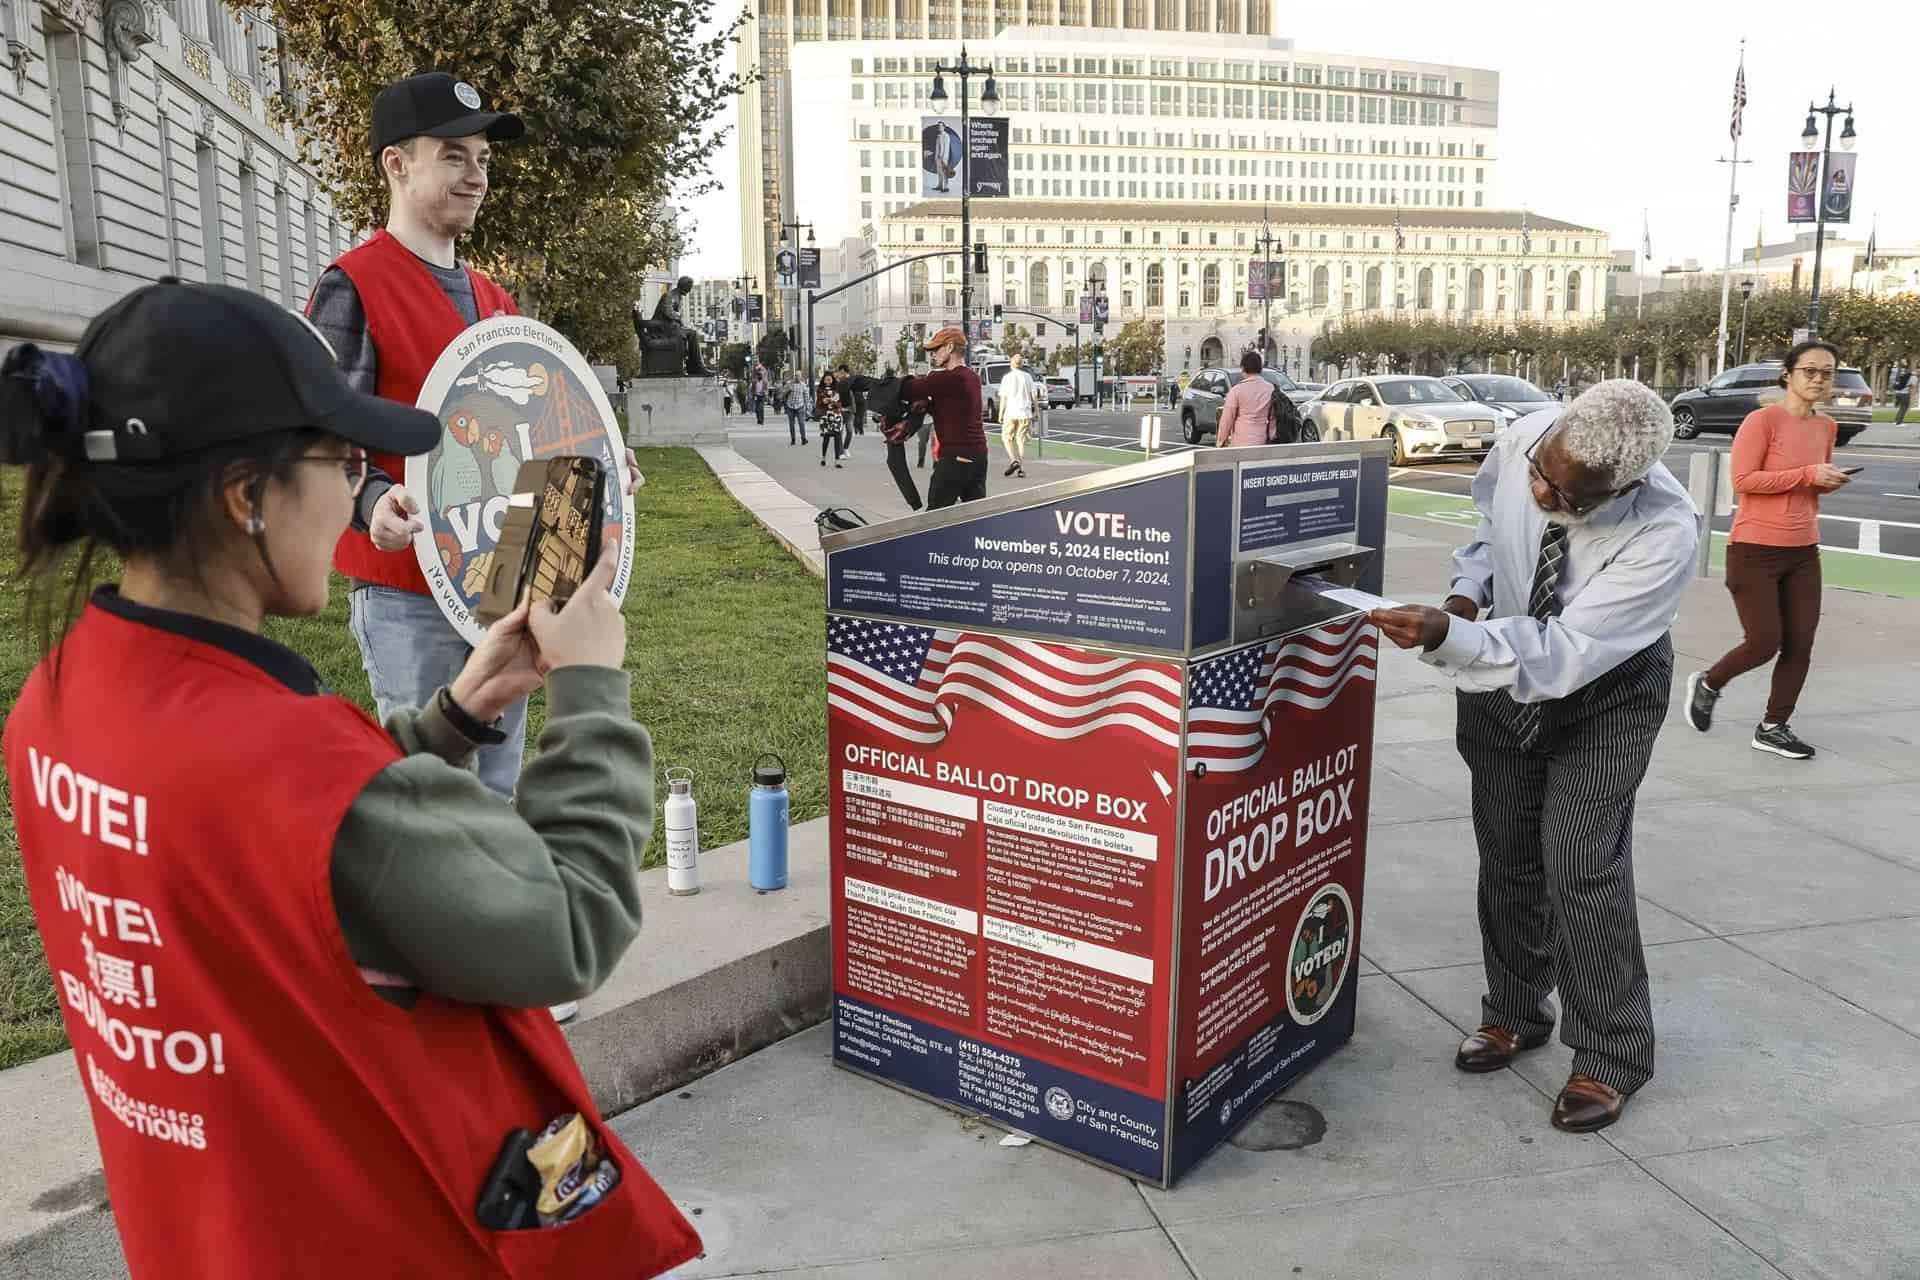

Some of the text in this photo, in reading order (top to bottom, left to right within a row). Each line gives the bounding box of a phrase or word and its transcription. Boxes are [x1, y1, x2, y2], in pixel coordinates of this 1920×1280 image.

[457, 325, 562, 360] San Francisco Elections
[1244, 469, 1357, 489] INSERT SIGNED BALLOT ENVELOPE BELOW
[1055, 510, 1171, 543] VOTE in the
[975, 537, 1170, 565] November 5, 2024 Election!
[928, 552, 1171, 586] This drop box opens on October 7, 2024.
[844, 743, 1148, 823] OFFICIAL BALLOT DROP BOX
[1206, 744, 1358, 841] OFFICIAL BALLOT
[28, 746, 148, 856] VOTE!
[986, 804, 1125, 839] Ciudad y Condado de San Francisco
[987, 814, 1002, 826] Caja
[1004, 818, 1027, 829] oficial
[1028, 824, 1045, 834] para
[1047, 826, 1090, 843] devolución
[1092, 835, 1102, 845] de
[1104, 838, 1134, 853] boletas
[1204, 812, 1288, 903] DROP
[1296, 778, 1355, 848] BOX
[1319, 924, 1325, 944] I
[1295, 937, 1345, 982] VOTED!
[882, 1034, 891, 1042] CA
[959, 1040, 1021, 1068] (415) 554-4375
[976, 1056, 993, 1070] (415)
[1255, 1070, 1272, 1089] County
[1280, 1057, 1290, 1070] San
[1291, 1040, 1316, 1061] Francisco
[1076, 1115, 1159, 1150] of San Francisco
[1077, 1100, 1156, 1136] City and County
